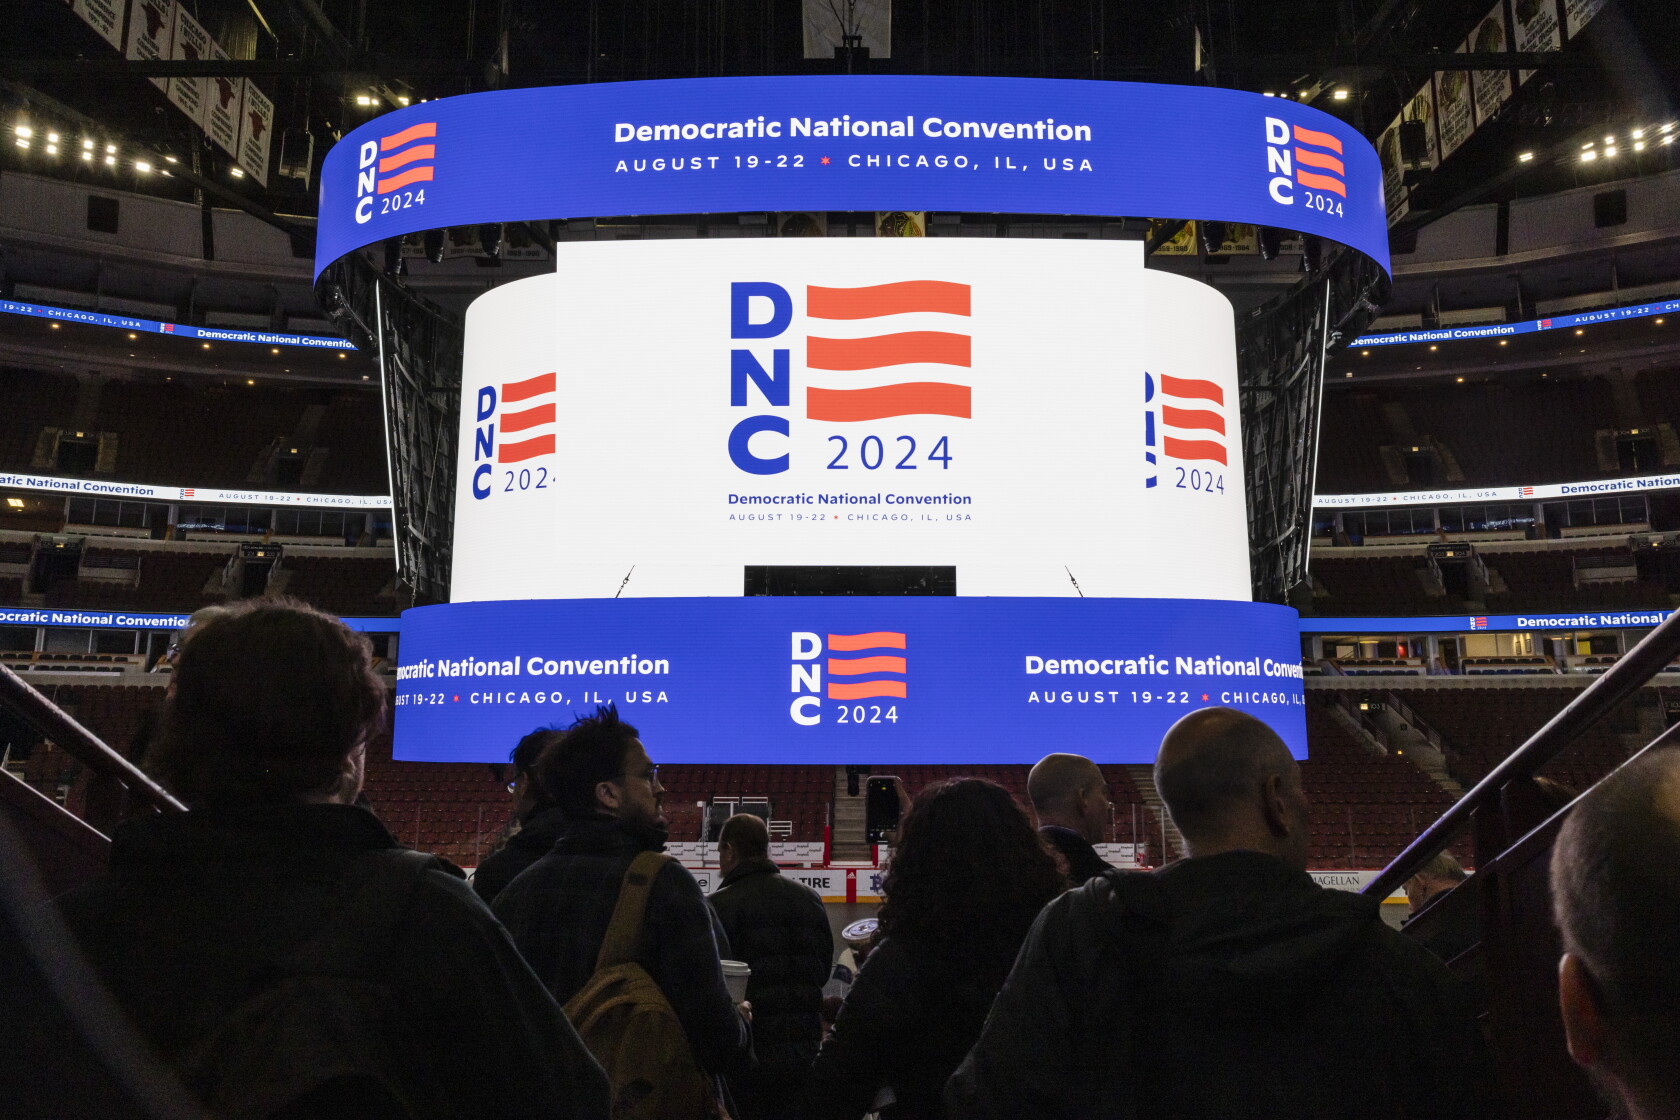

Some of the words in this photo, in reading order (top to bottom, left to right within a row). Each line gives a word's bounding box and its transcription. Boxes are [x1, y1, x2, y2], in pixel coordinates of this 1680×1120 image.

[180, 11, 206, 45] CHICAGO
[615, 116, 781, 142] Democratic
[791, 115, 913, 137] National
[923, 118, 1091, 141] Convention
[616, 157, 719, 172] AUGUST
[735, 155, 804, 168] 19-22
[849, 154, 978, 170] CHICAGO,
[995, 157, 1028, 172] IL,
[1043, 158, 1092, 172] USA
[1266, 117, 1293, 205] DNC
[356, 141, 377, 224] DNC
[381, 189, 425, 214] 2024
[1305, 192, 1343, 218] 2024
[3, 303, 33, 313] 19-22
[48, 310, 98, 322] CHICAGO,
[103, 317, 117, 325] IL,
[121, 319, 141, 328] USA
[1575, 312, 1616, 323] AUGUST
[1621, 307, 1649, 316] 19-22
[197, 330, 256, 341] Democratic
[257, 334, 300, 345] National
[1409, 331, 1452, 342] National
[1454, 326, 1514, 338] Convention
[728, 282, 792, 475] DNC
[473, 386, 496, 500] DNC
[827, 436, 952, 470] 2024
[26, 478, 80, 490] National
[83, 482, 154, 496] Convention
[505, 467, 555, 492] 202
[1176, 467, 1224, 495] 2024
[1561, 481, 1633, 494] Democratic
[1637, 477, 1680, 488] Nation
[306, 497, 354, 505] CHICAGO,
[728, 493, 813, 505] Democratic
[818, 493, 880, 505] National
[885, 493, 972, 505] Convention
[1403, 493, 1453, 501] CHICAGO,
[847, 514, 913, 522] CHICAGO,
[921, 514, 938, 522] IL,
[0, 612, 48, 623] ocratic
[52, 613, 113, 625] National
[1517, 615, 1597, 627] Democratic
[1600, 613, 1663, 625] National
[438, 656, 520, 677] National
[527, 654, 669, 675] Convention
[1026, 655, 1169, 675] Democratic
[1176, 655, 1260, 677] National
[790, 632, 822, 725] DNC
[413, 693, 445, 705] 19-22
[470, 691, 571, 705] CHICAGO,
[584, 691, 612, 705] IL,
[625, 691, 669, 703] USA
[1028, 691, 1119, 703] AUGUST
[1131, 691, 1189, 703] 19-22
[1221, 691, 1290, 706] CHICAGO,
[838, 706, 898, 723] 2024
[800, 878, 830, 888] TIRE
